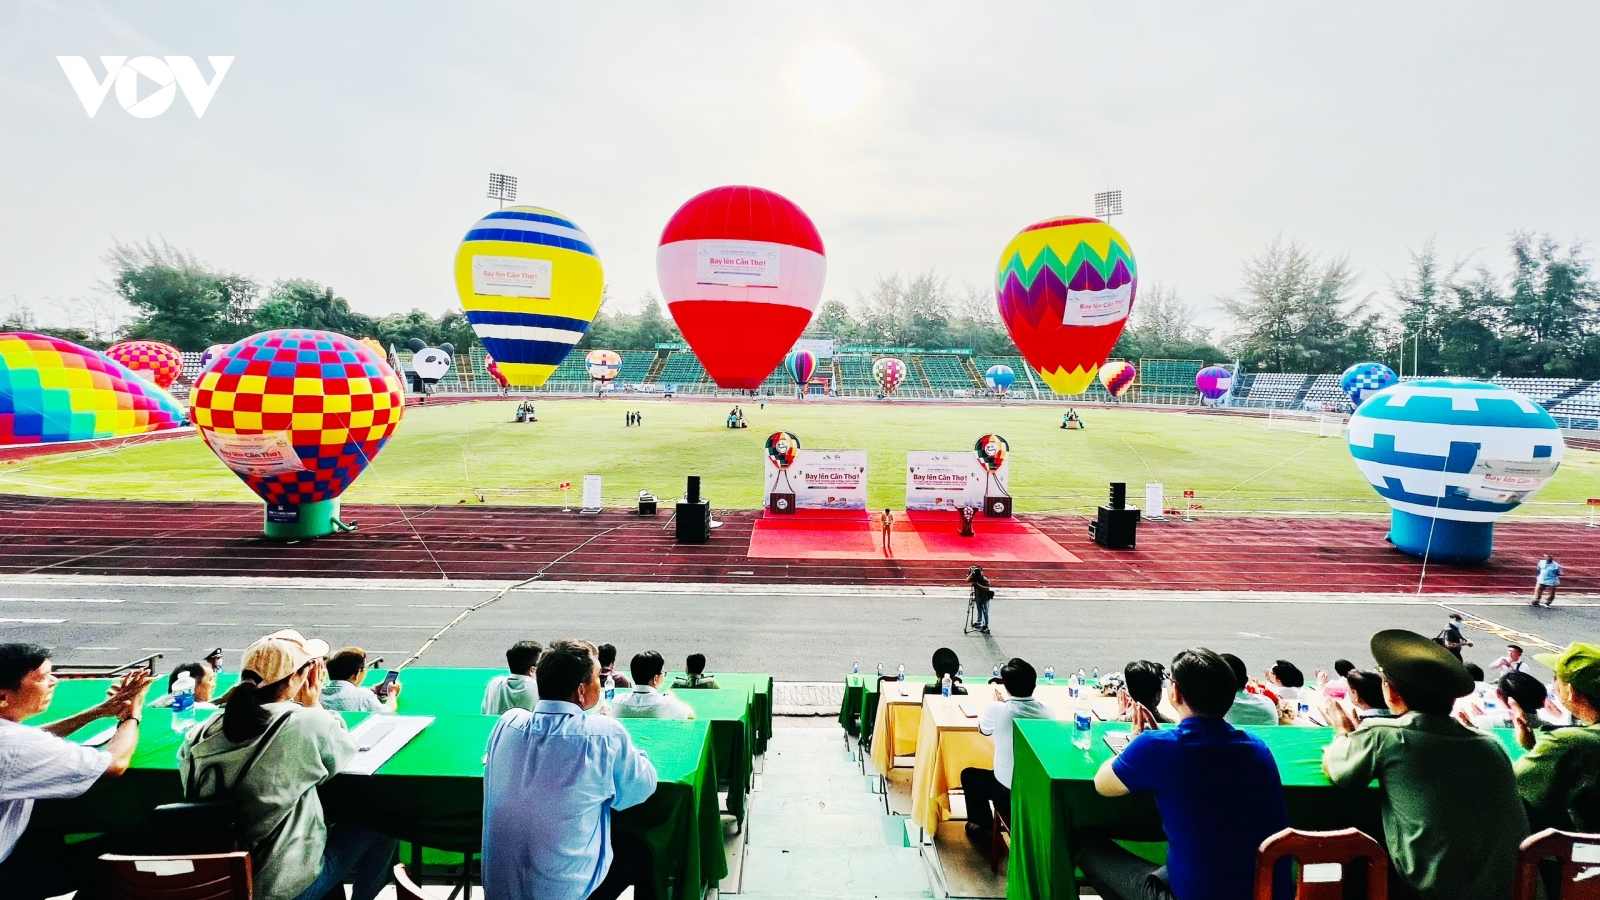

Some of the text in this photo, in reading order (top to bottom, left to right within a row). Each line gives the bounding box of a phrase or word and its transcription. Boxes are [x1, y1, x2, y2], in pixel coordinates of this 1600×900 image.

[709, 257, 723, 265] Bay
[483, 270, 494, 278] Bay
[818, 472, 829, 480] lên
[830, 472, 843, 480] Cần
[913, 473, 926, 481] Bay
[926, 473, 937, 481] lên
[938, 473, 951, 481] Cần
